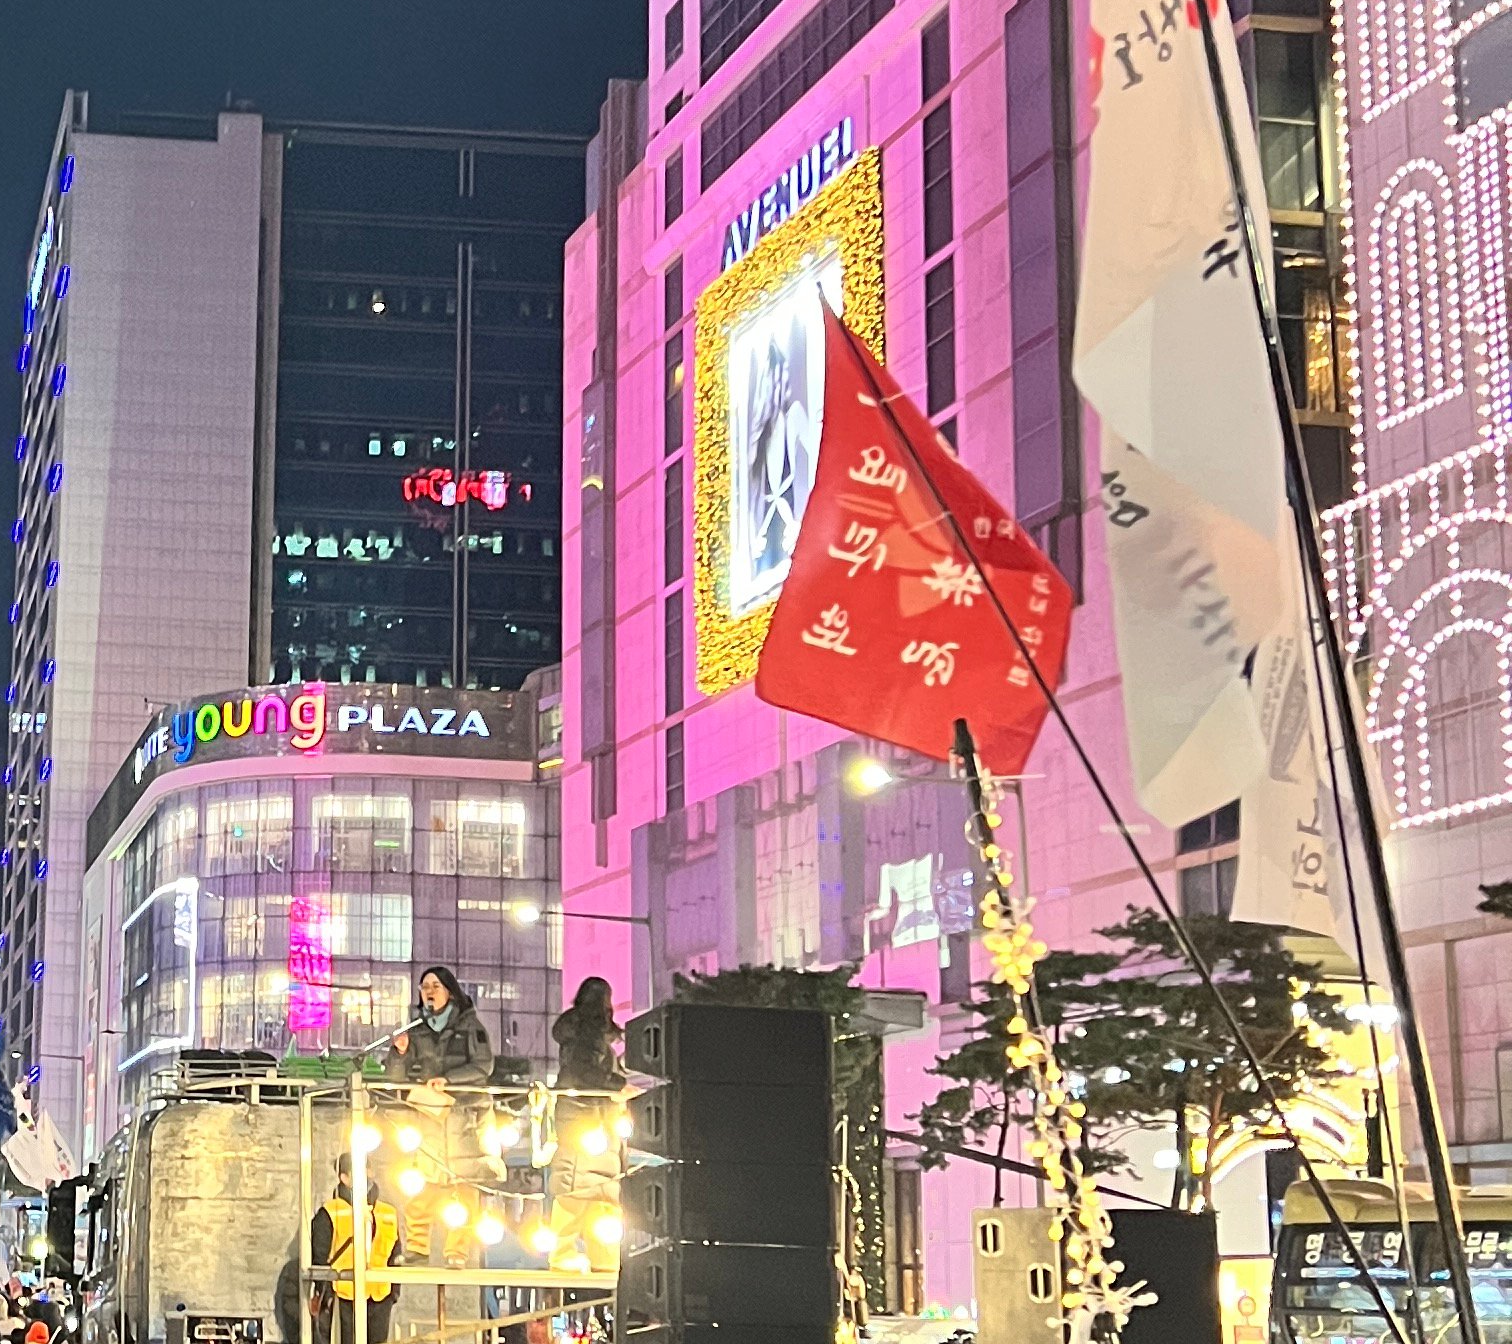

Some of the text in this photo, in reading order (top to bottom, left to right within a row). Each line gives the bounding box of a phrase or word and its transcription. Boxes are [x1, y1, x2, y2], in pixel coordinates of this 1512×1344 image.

[723, 116, 859, 270] AVENUEL
[172, 693, 326, 764] young
[338, 704, 491, 738] PLAZA
